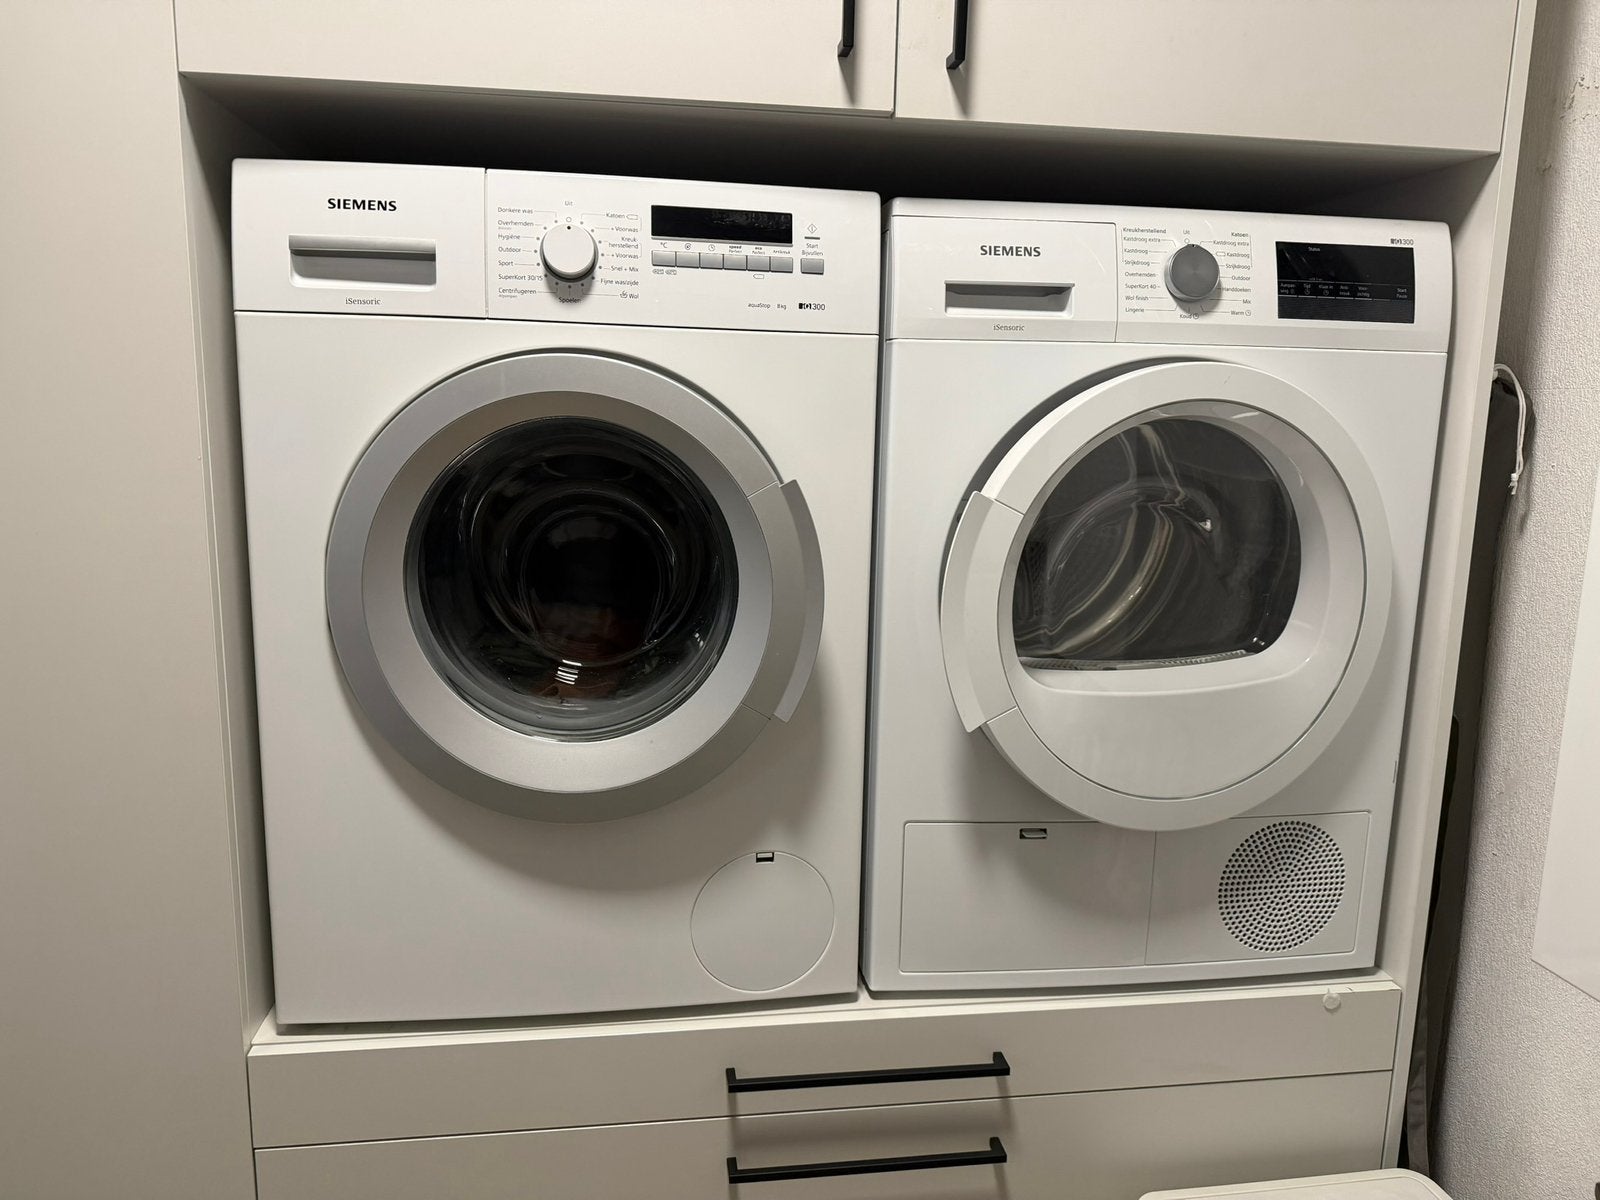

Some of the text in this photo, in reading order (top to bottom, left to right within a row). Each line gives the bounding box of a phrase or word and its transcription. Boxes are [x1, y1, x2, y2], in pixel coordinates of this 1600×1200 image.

[328, 198, 397, 212] SIEMENS
[980, 244, 1041, 257] SIEMENS
[346, 296, 381, 305] iSensoric
